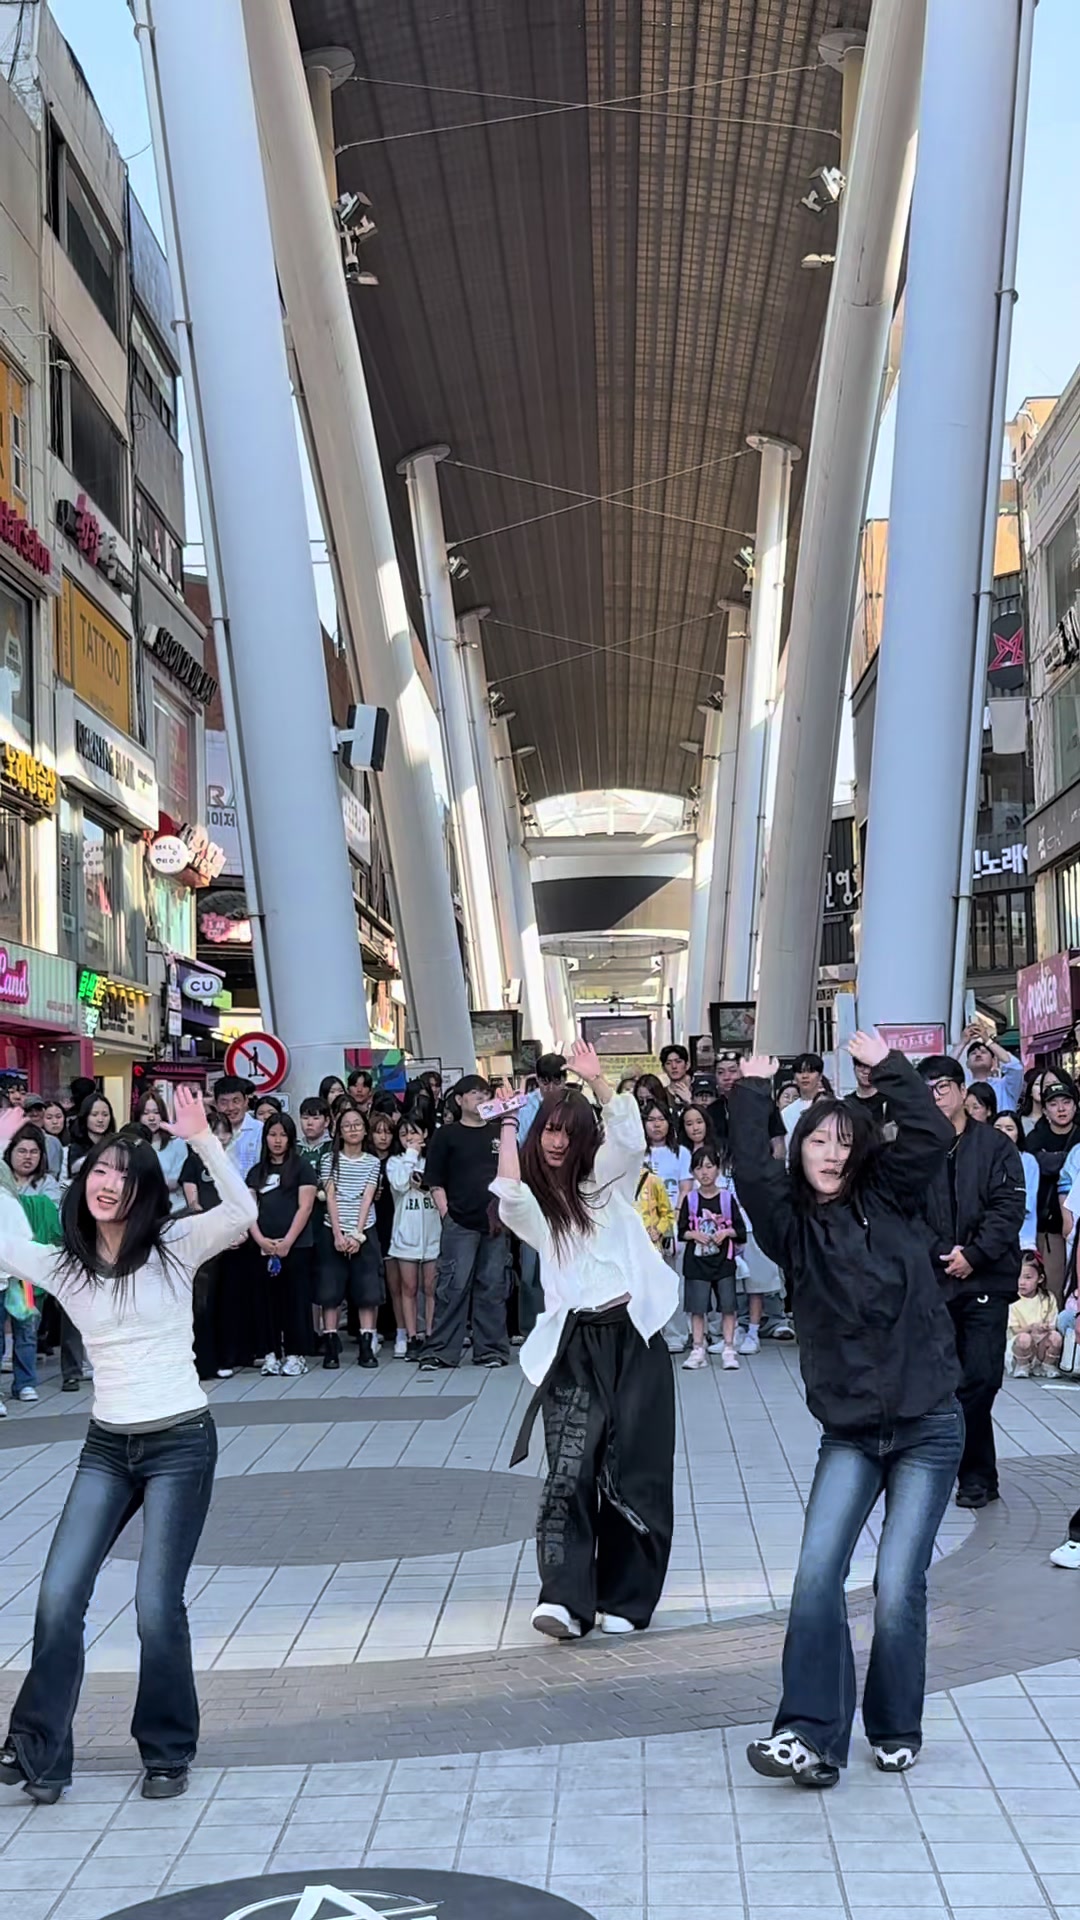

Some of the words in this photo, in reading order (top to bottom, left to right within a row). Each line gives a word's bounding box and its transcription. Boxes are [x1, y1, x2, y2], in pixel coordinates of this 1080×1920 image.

[80, 613, 120, 686] TATTOO
[5, 741, 57, 806] 노래연습장
[190, 980, 213, 992] CU
